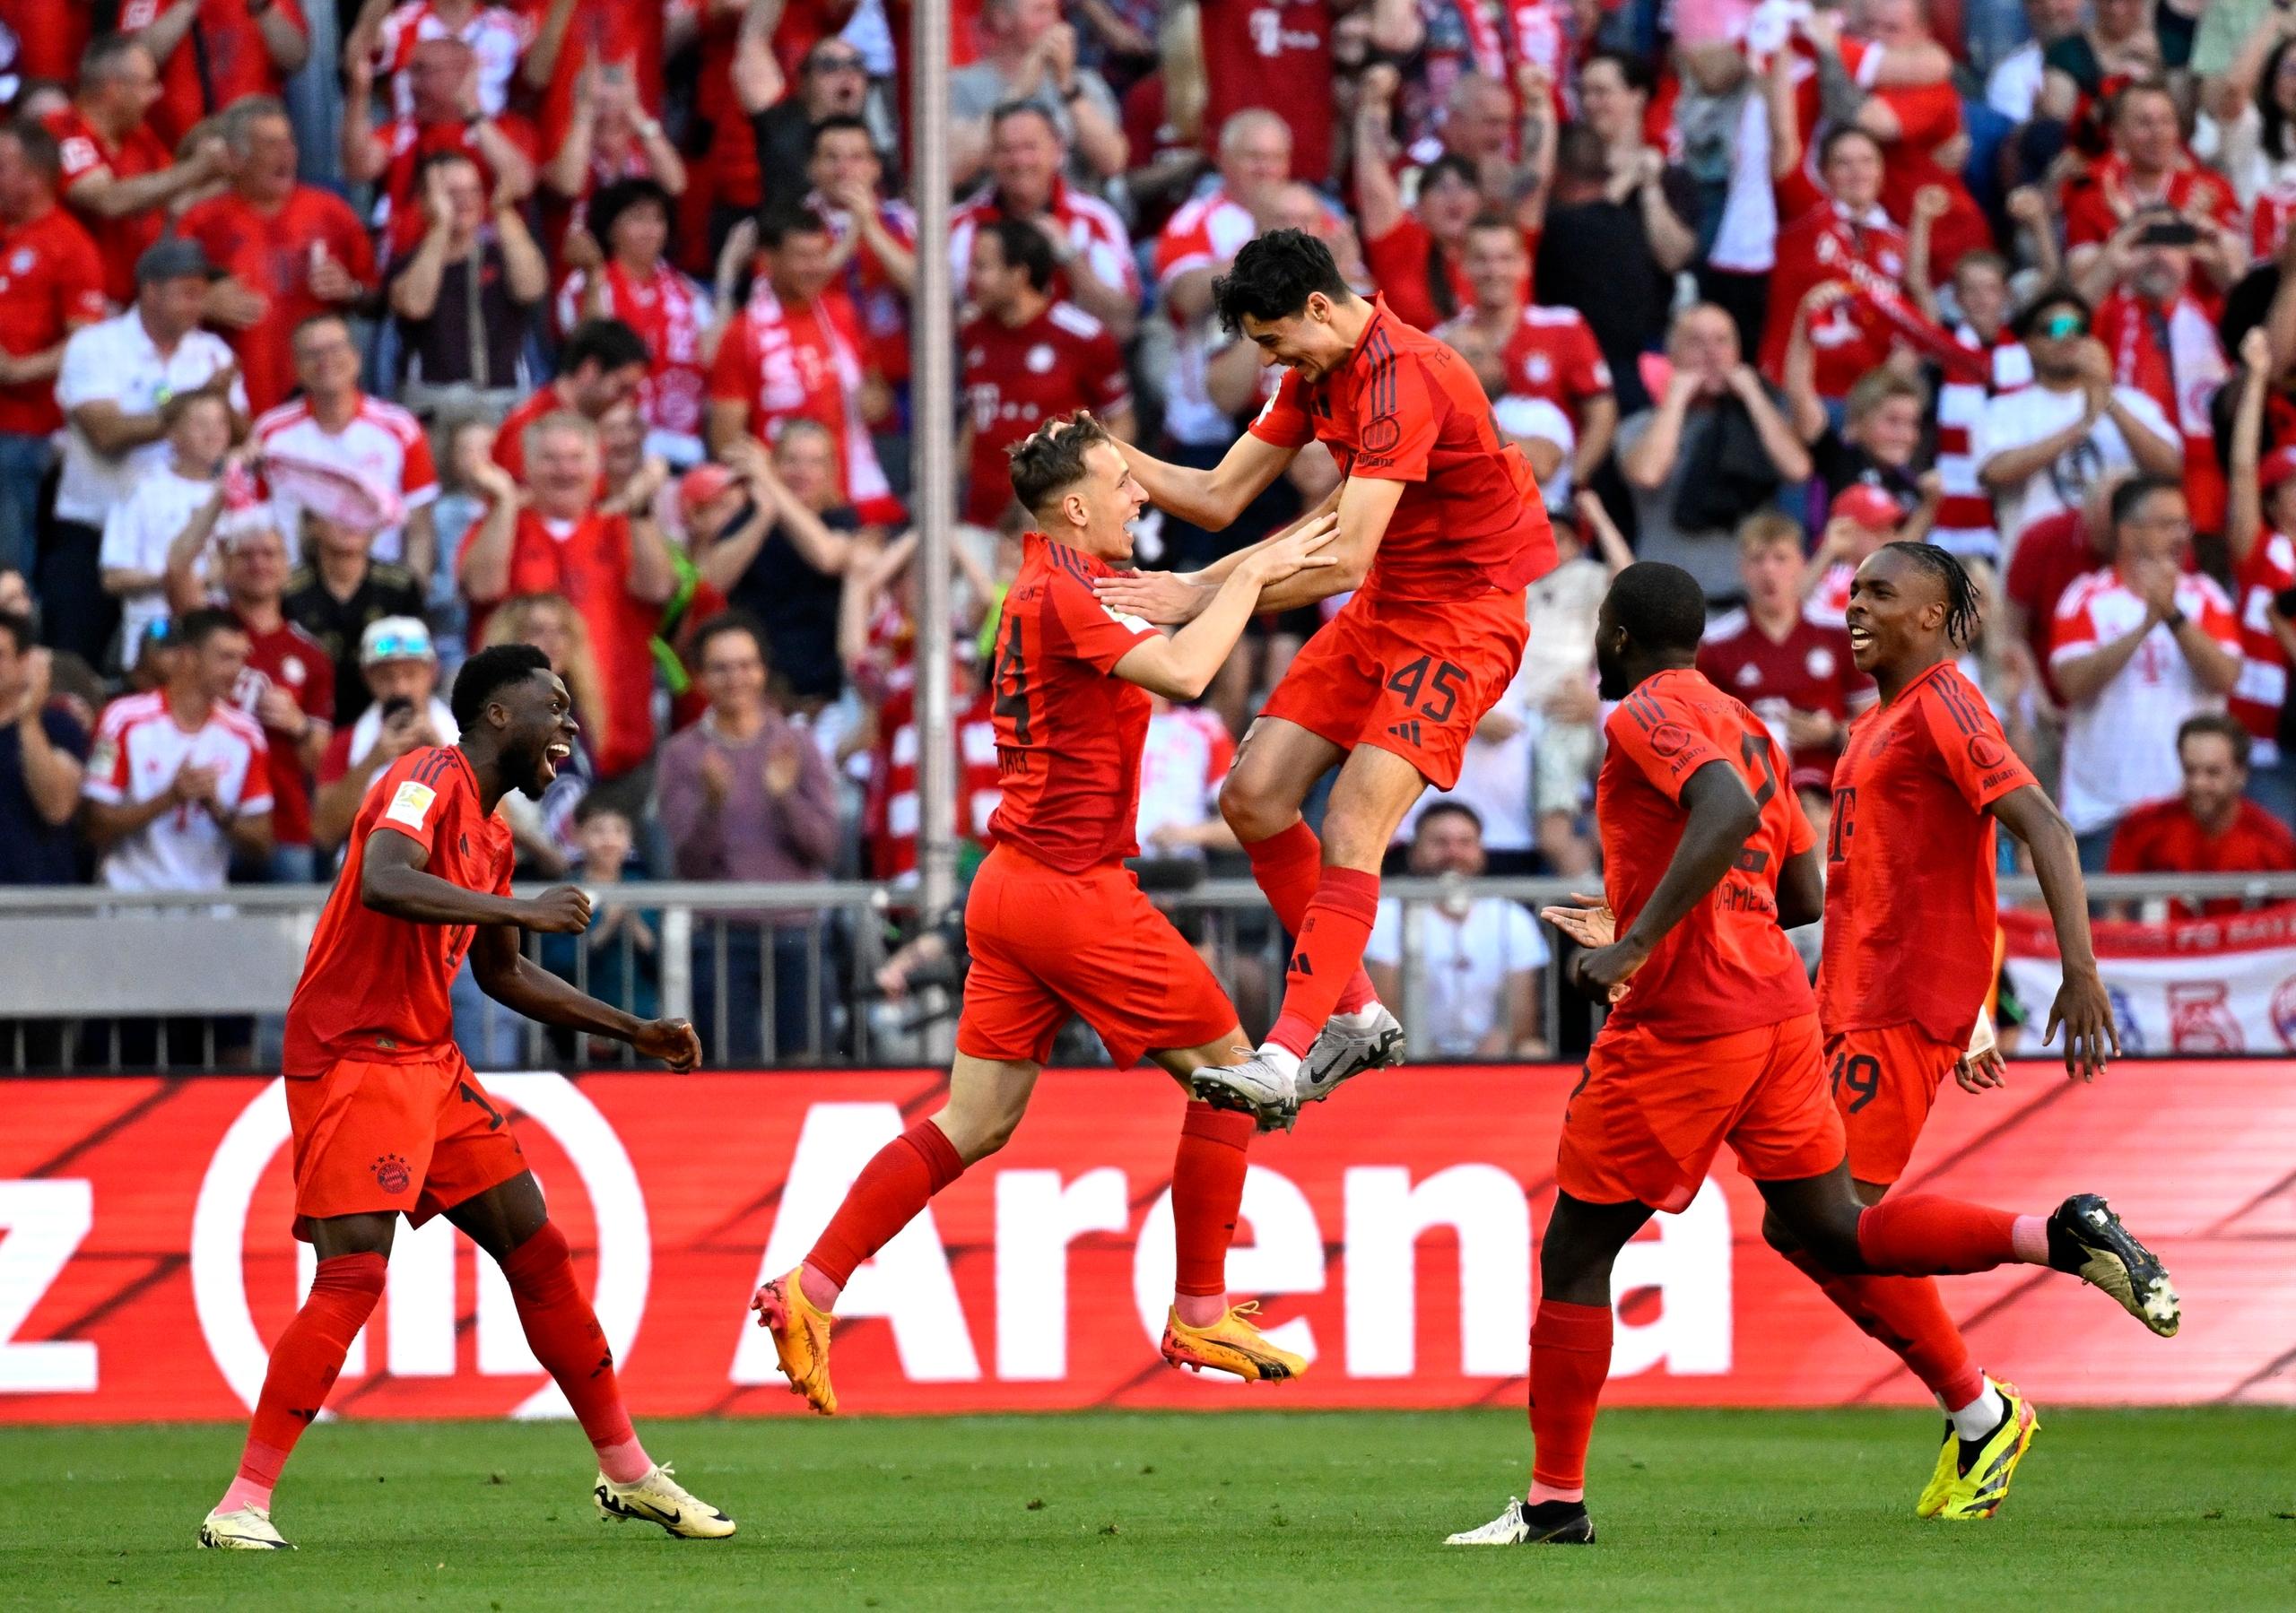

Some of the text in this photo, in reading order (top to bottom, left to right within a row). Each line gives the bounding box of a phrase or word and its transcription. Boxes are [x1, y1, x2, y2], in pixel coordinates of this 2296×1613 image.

[1357, 452, 1396, 467] Allianz
[1387, 655, 1468, 723] 45
[1670, 746, 1709, 776] Allianz
[1829, 1051, 1881, 1114] 19
[732, 1103, 1731, 1382] Arena
